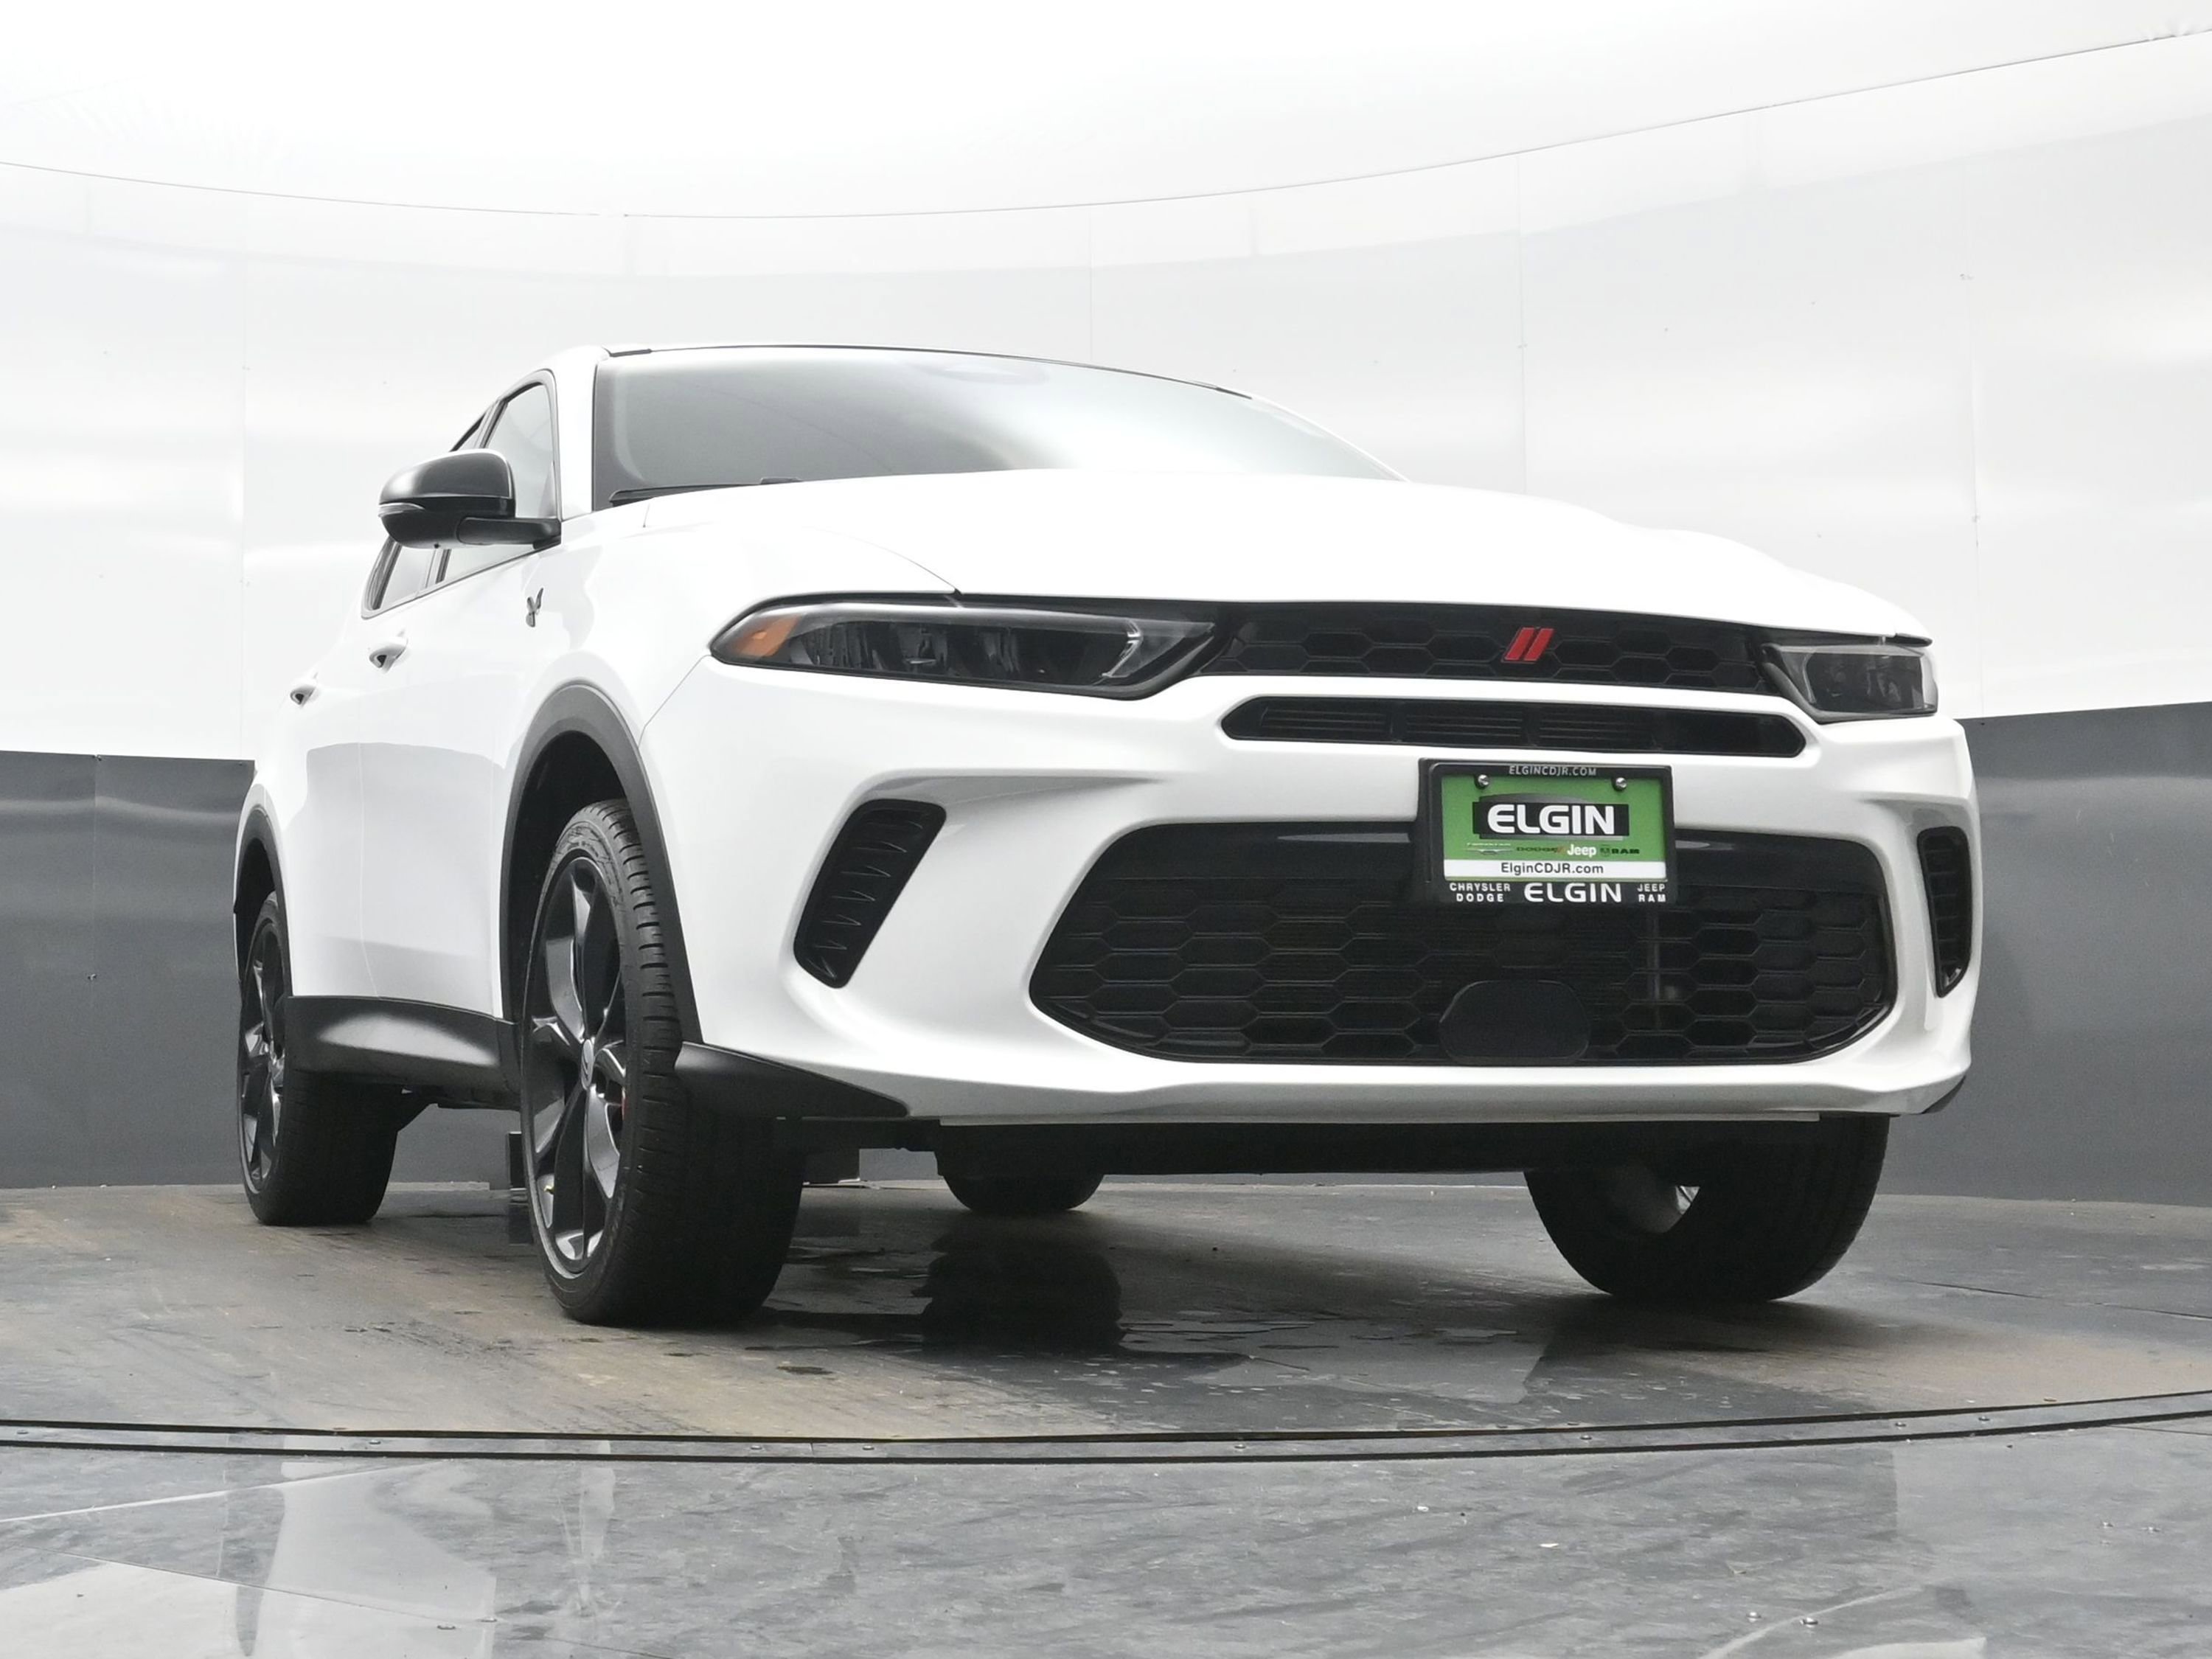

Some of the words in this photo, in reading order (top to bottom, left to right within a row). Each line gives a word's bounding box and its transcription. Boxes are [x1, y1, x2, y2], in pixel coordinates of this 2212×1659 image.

[1509, 765, 1596, 776] ELGINCDJR.COM
[1487, 804, 1615, 835] ELGIN
[1567, 844, 1596, 858] Jeep
[1500, 862, 1604, 876] ElginCDJR.com
[1450, 883, 1511, 892] CHRYSLER
[1523, 883, 1621, 903] ELGIN
[1637, 884, 1666, 892] JEEP
[1456, 894, 1504, 902] DODGE
[1638, 894, 1666, 903] RAM
